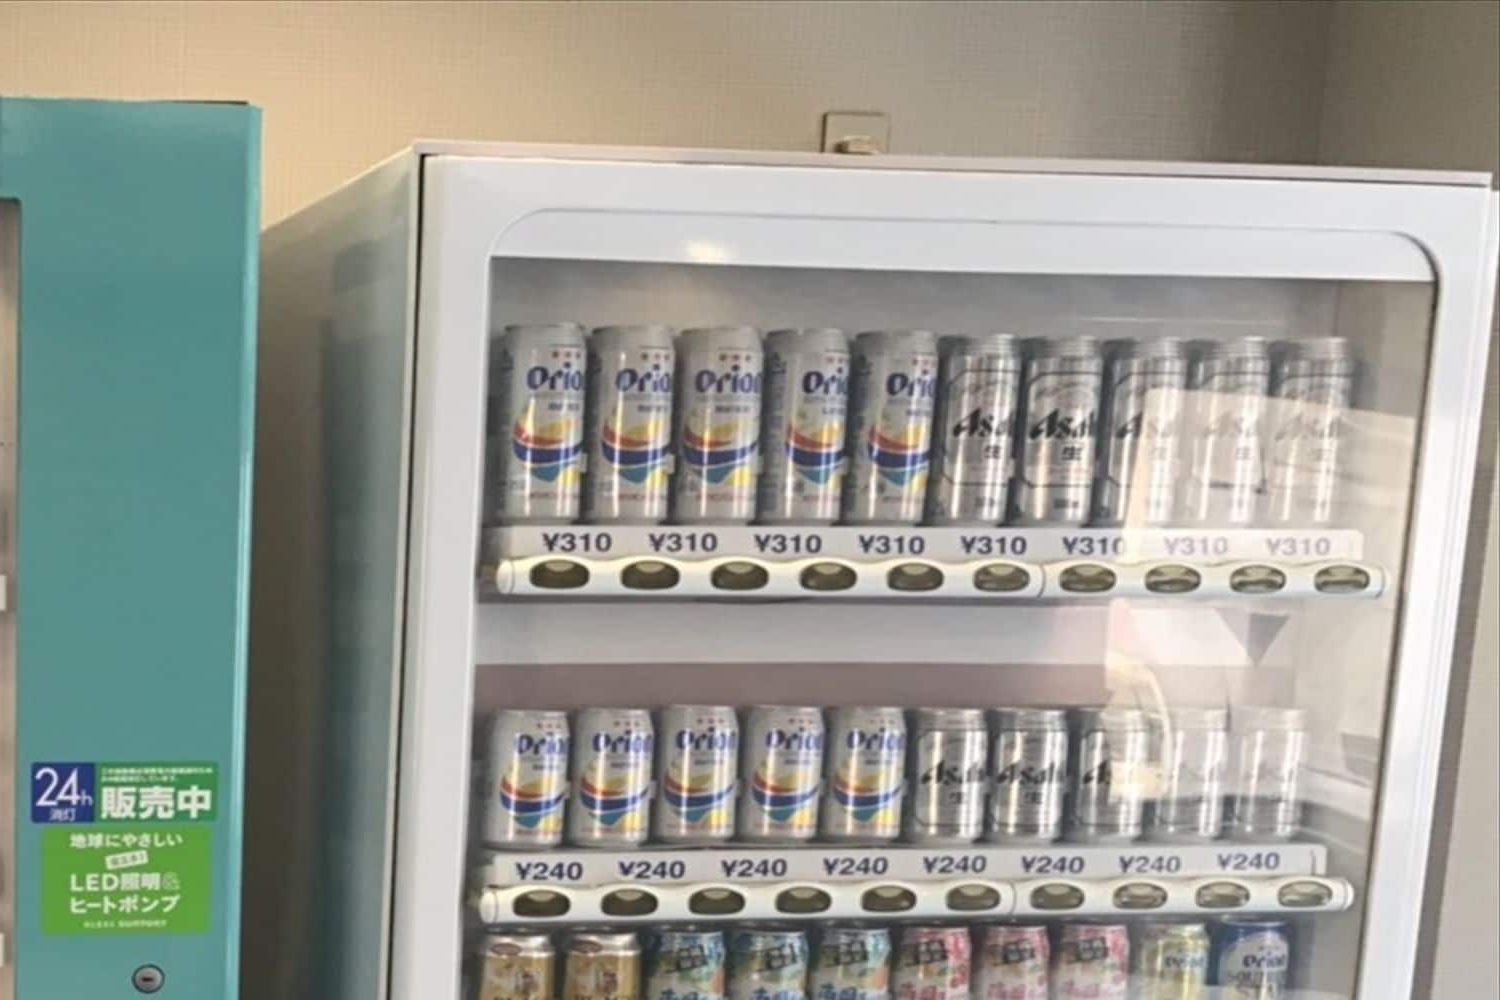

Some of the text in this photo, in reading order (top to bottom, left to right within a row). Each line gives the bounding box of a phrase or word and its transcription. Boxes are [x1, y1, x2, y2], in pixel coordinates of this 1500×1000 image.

[526, 361, 584, 391] Orio
[615, 363, 672, 393] Orio
[802, 365, 851, 395] Orio
[886, 367, 938, 397] Orio
[952, 407, 1012, 438] Asa
[1029, 406, 1096, 440] Asa
[542, 532, 613, 553] ¥310
[648, 533, 718, 553] ¥310
[753, 533, 822, 554] ¥310
[858, 534, 925, 555] ¥310
[960, 535, 1028, 556] ¥310
[1061, 535, 1125, 556] ¥310
[1163, 536, 1229, 557] ¥310
[1265, 536, 1331, 557] ¥310
[514, 733, 569, 756] Orio
[35, 767, 93, 806] 24h
[100, 785, 212, 819] 販売中
[69, 833, 183, 849] 地球にやさしい
[515, 862, 583, 881] ¥240
[618, 860, 686, 880] ¥240
[720, 858, 787, 878] ¥240
[823, 856, 889, 876] ¥240
[922, 855, 988, 874] ¥240
[1021, 855, 1086, 874] ¥240
[1119, 854, 1182, 873] ¥240
[1217, 852, 1281, 871] ¥240
[70, 872, 181, 892] LED照明&
[70, 895, 181, 914] ヒートポンプ
